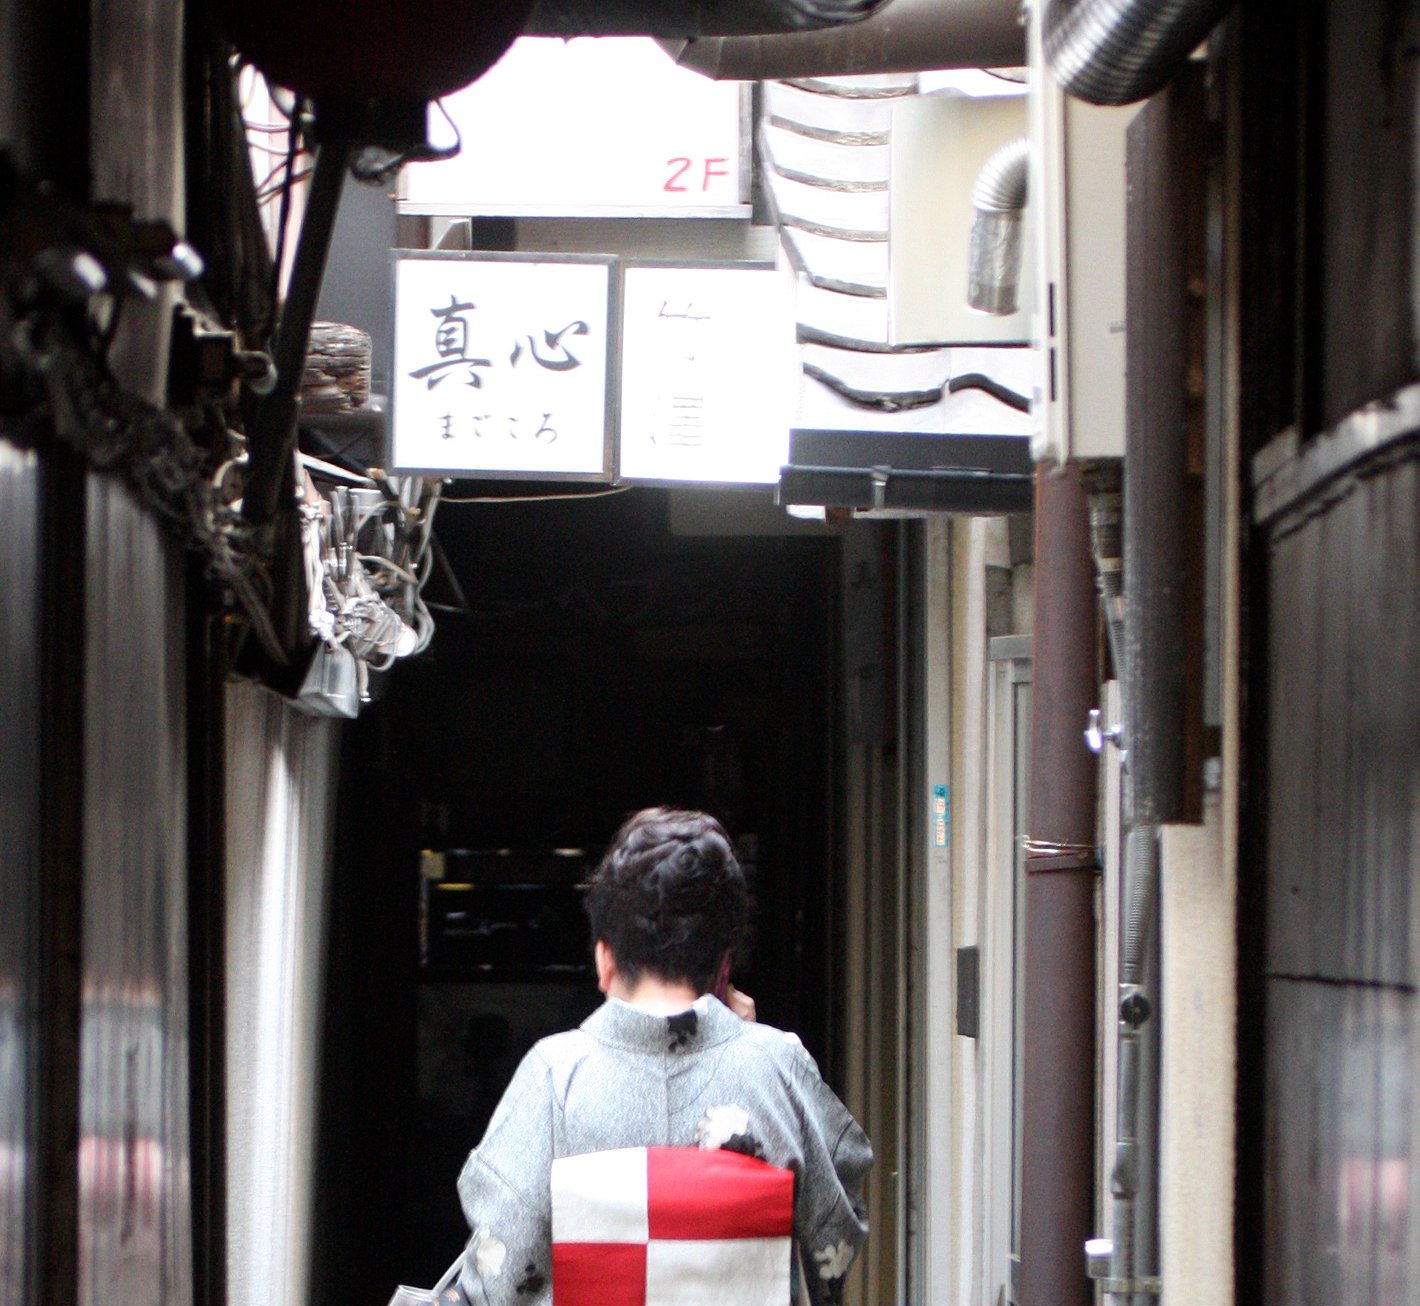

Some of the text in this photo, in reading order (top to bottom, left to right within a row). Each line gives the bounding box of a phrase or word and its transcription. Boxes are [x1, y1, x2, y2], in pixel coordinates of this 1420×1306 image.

[662, 156, 730, 193] 2F
[408, 294, 591, 391] 真心
[439, 412, 558, 444] まごころ
